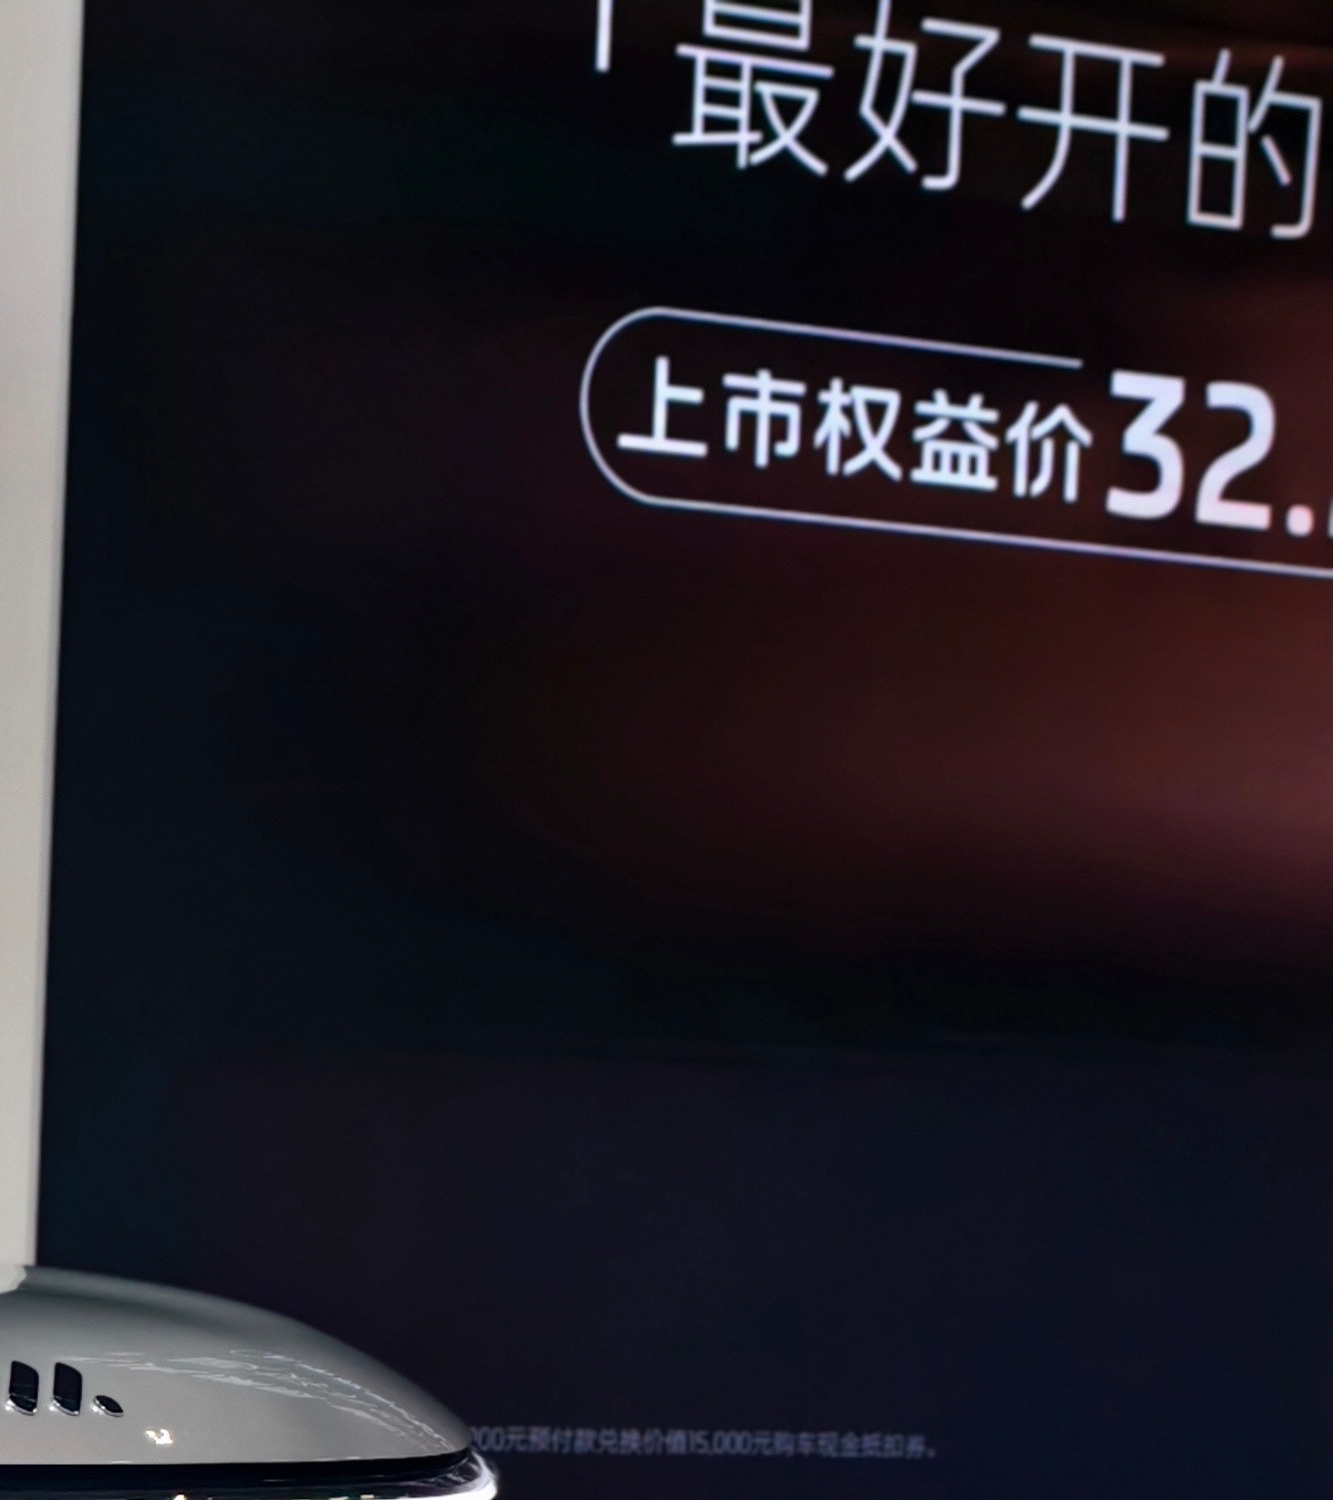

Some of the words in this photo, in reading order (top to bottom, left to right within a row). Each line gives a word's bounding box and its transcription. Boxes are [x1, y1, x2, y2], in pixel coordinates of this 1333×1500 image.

[617, 355, 1333, 538] 上市权益价32.
